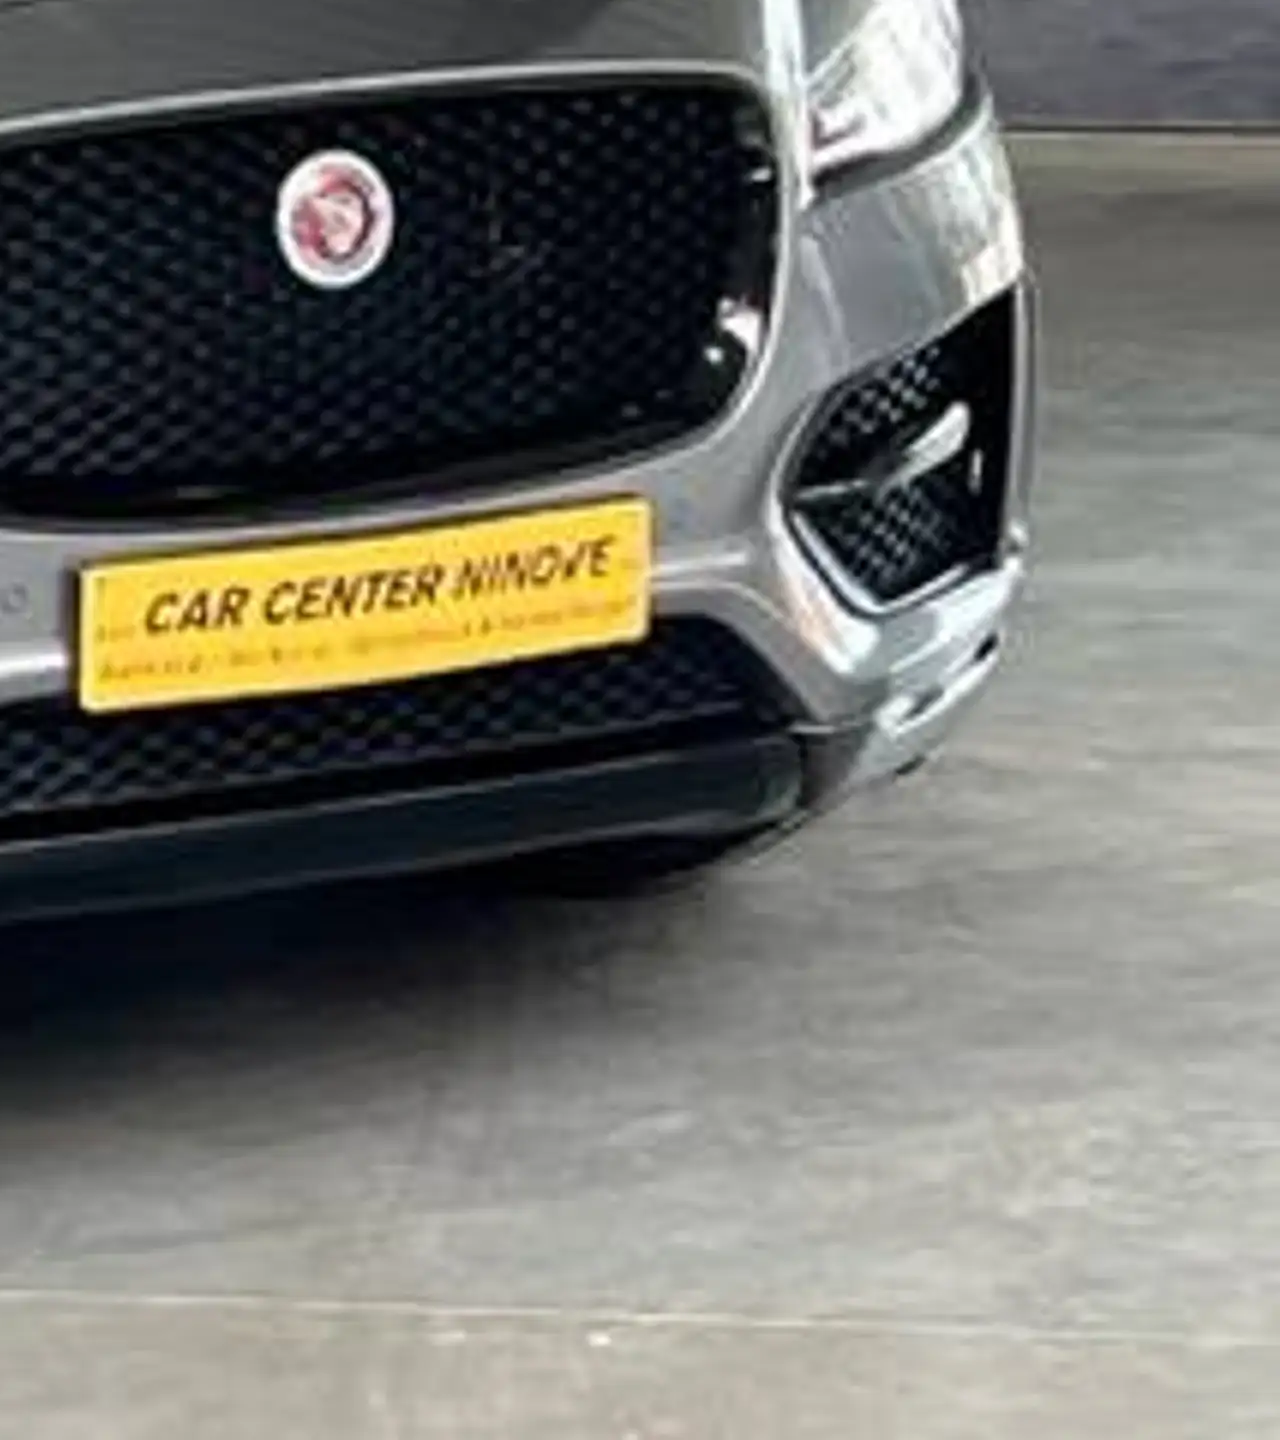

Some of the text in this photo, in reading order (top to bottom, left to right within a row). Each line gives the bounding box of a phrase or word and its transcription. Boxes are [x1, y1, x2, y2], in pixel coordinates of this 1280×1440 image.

[143, 534, 614, 636] CAR CENTER NINOVE
